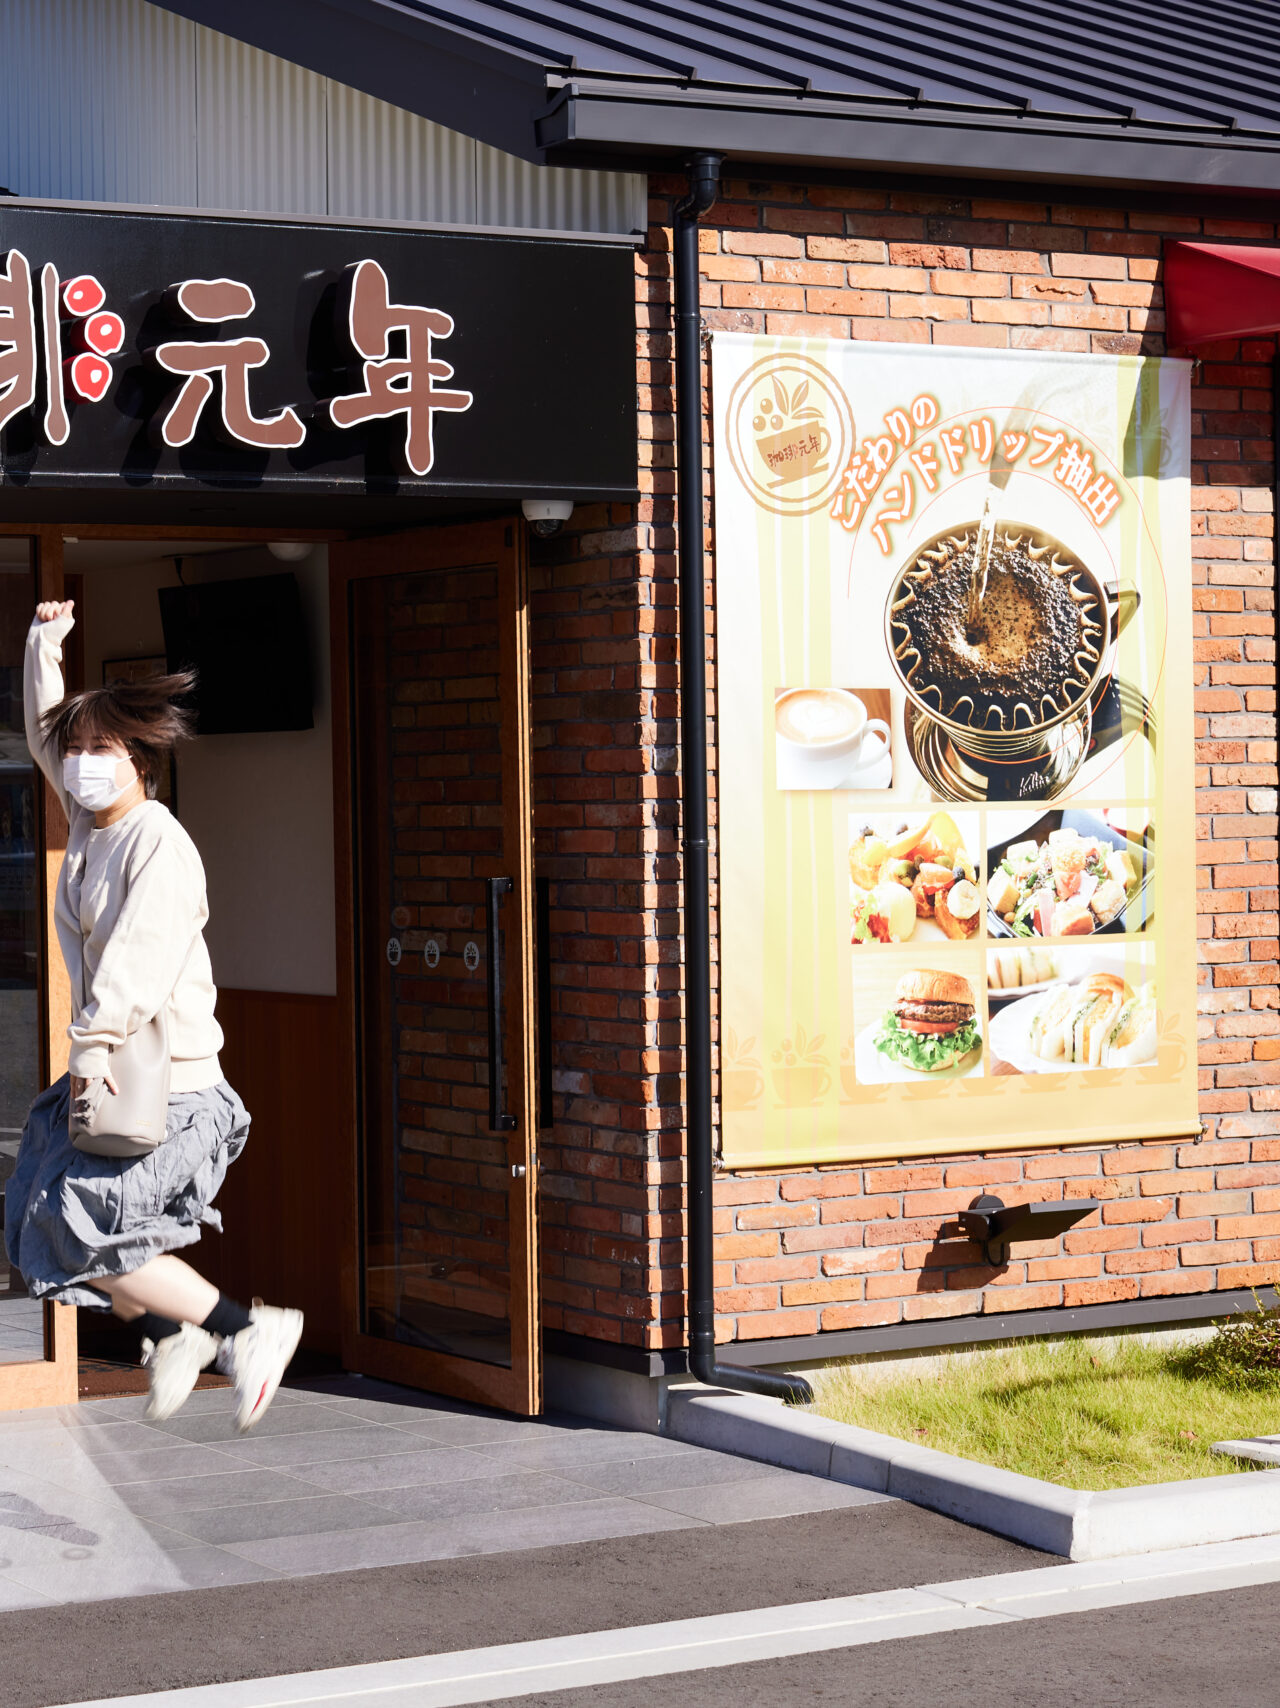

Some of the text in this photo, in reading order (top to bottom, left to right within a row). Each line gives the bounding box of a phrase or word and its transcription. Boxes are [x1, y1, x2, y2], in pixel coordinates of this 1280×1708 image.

[831, 394, 938, 531] こだわりの
[872, 418, 1121, 554] ハンドドリップ抽出
